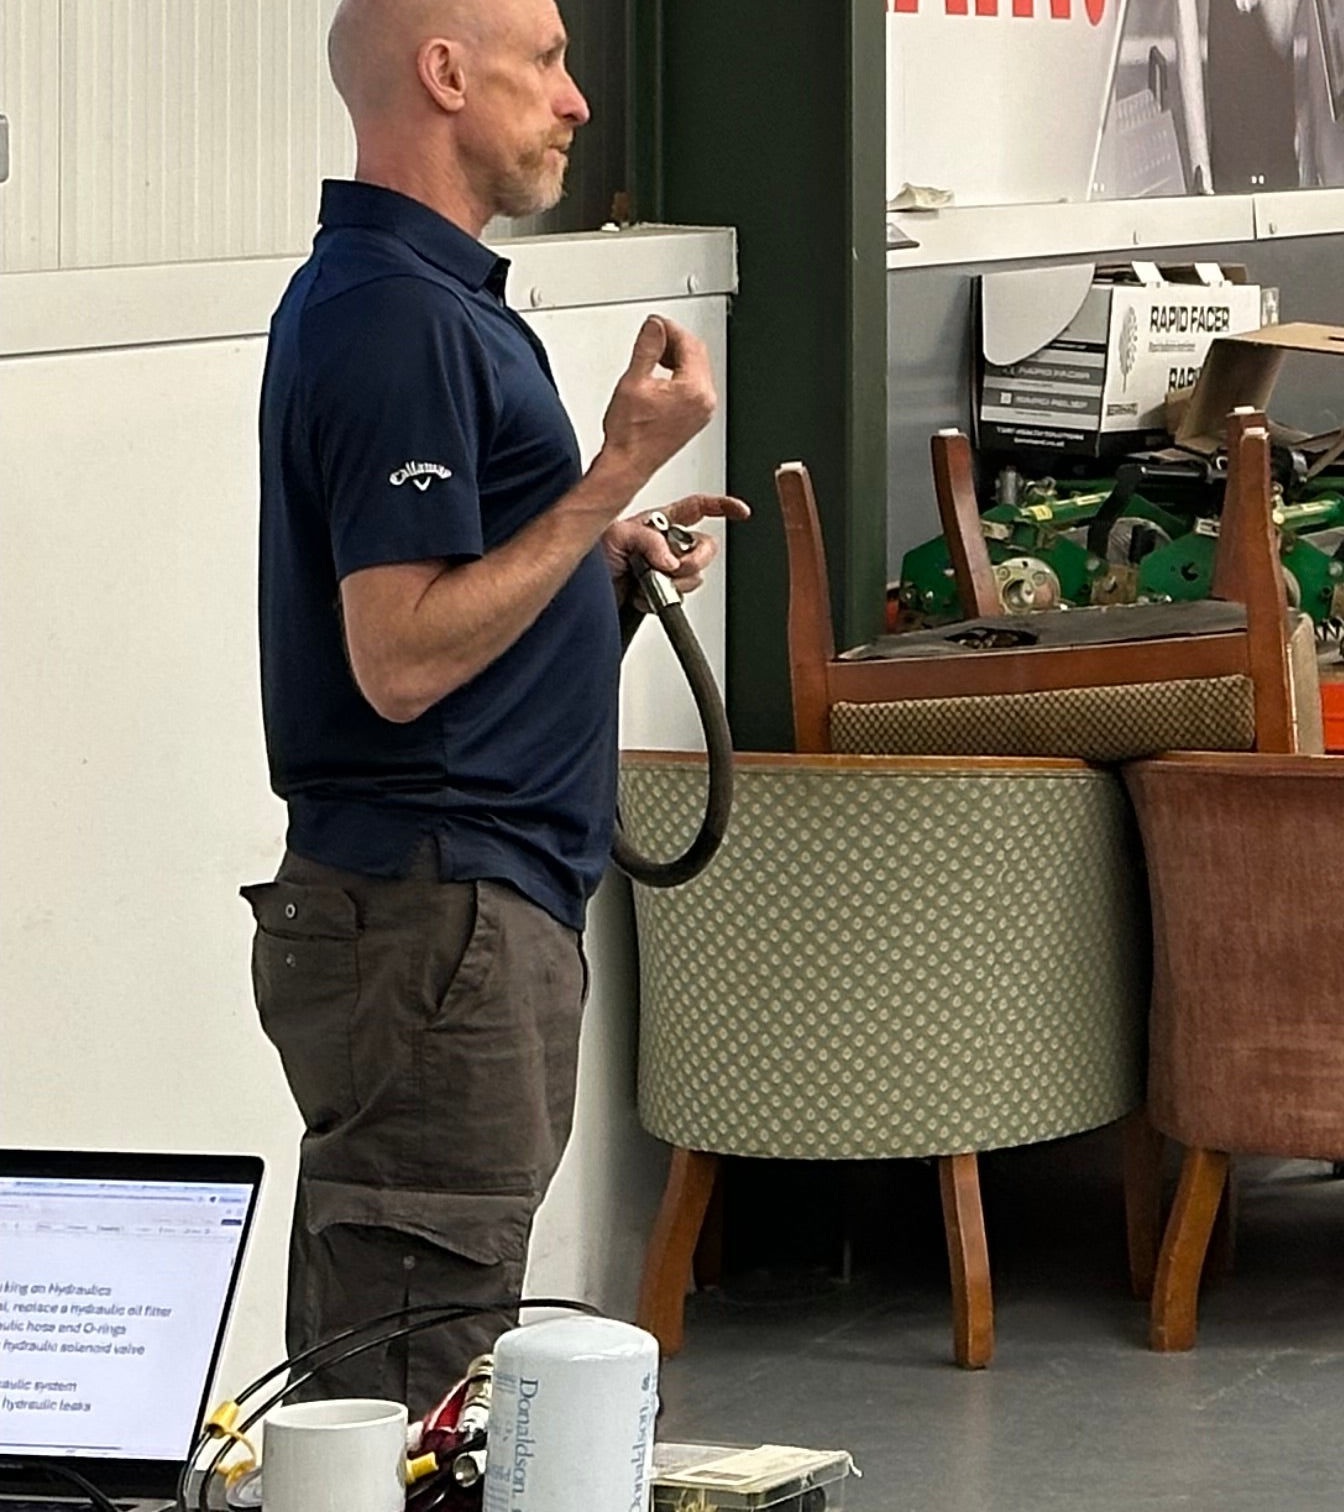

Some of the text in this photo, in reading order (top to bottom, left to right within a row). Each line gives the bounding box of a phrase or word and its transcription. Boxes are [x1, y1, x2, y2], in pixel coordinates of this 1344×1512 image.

[1150, 306, 1230, 332] RAPID FACER
[1168, 367, 1200, 391] RAP
